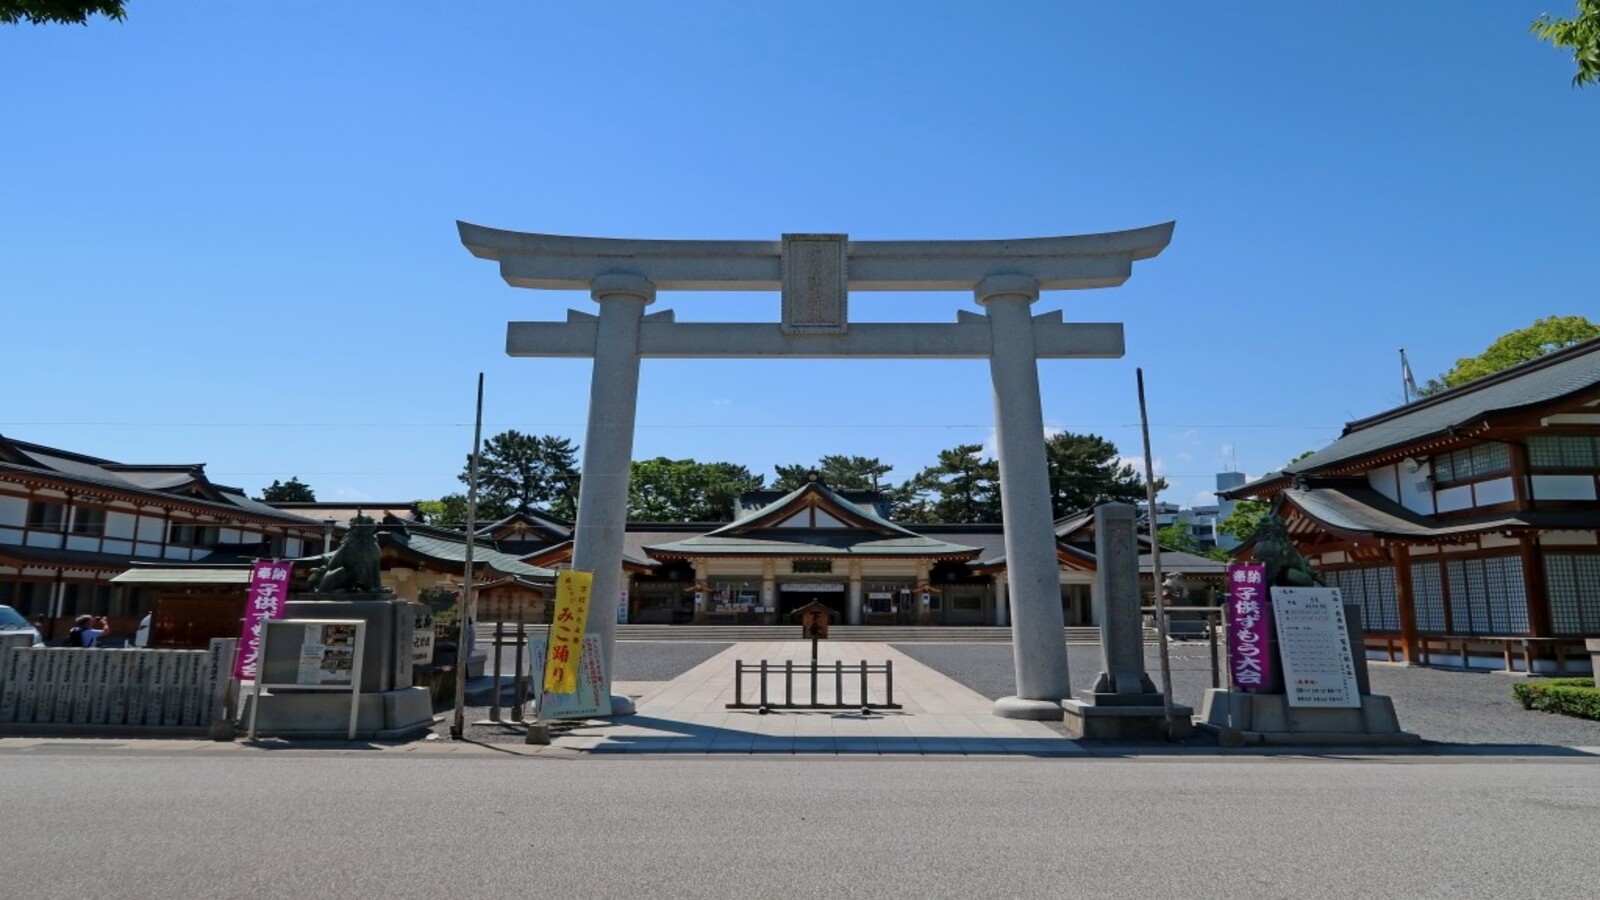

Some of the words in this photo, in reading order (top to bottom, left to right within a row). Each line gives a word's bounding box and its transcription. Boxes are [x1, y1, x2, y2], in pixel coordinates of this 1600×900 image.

[258, 567, 287, 581] 奉納
[1233, 570, 1262, 584] 奉納
[552, 607, 575, 683] みこ踊り
[1234, 587, 1262, 685] 子供ずもう大会
